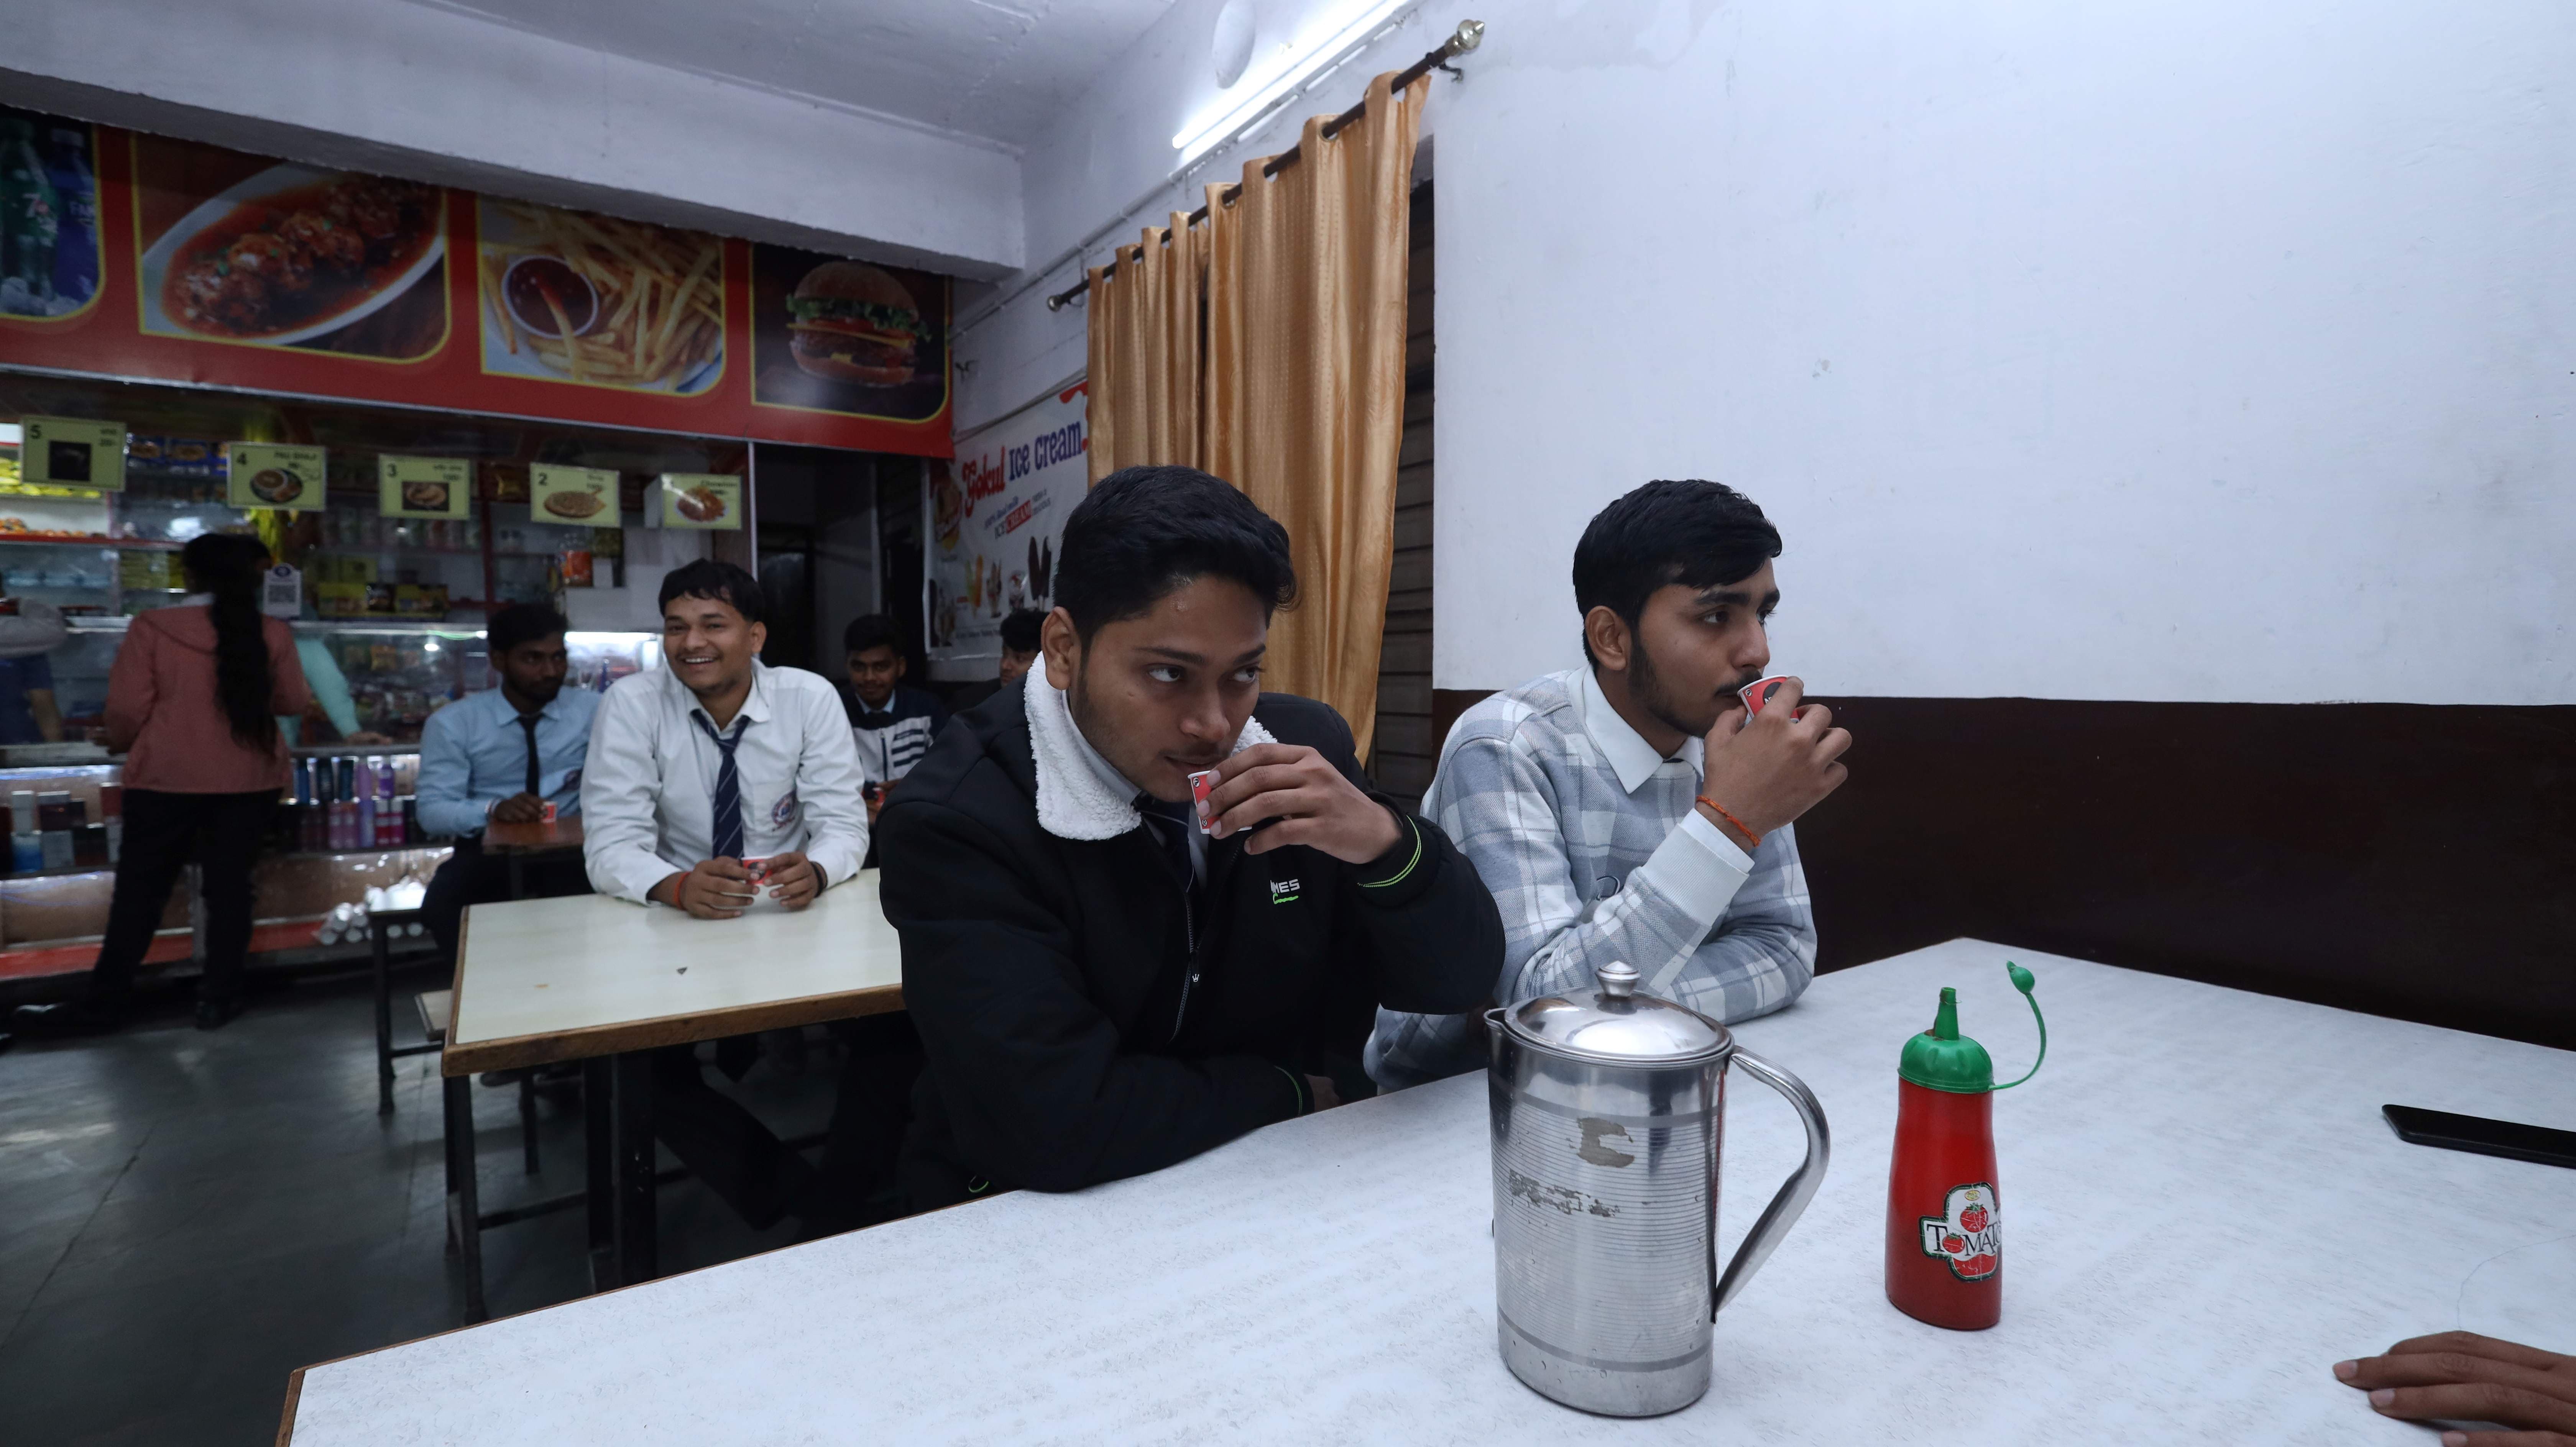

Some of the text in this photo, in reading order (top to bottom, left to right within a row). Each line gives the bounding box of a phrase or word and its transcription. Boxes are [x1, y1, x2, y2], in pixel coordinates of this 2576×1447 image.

[30, 424, 41, 440] 5
[236, 451, 247, 466] 4
[387, 463, 398, 477] 3
[961, 446, 1005, 518] Gokul
[1035, 421, 1082, 471] cream
[538, 472, 548, 486] 2
